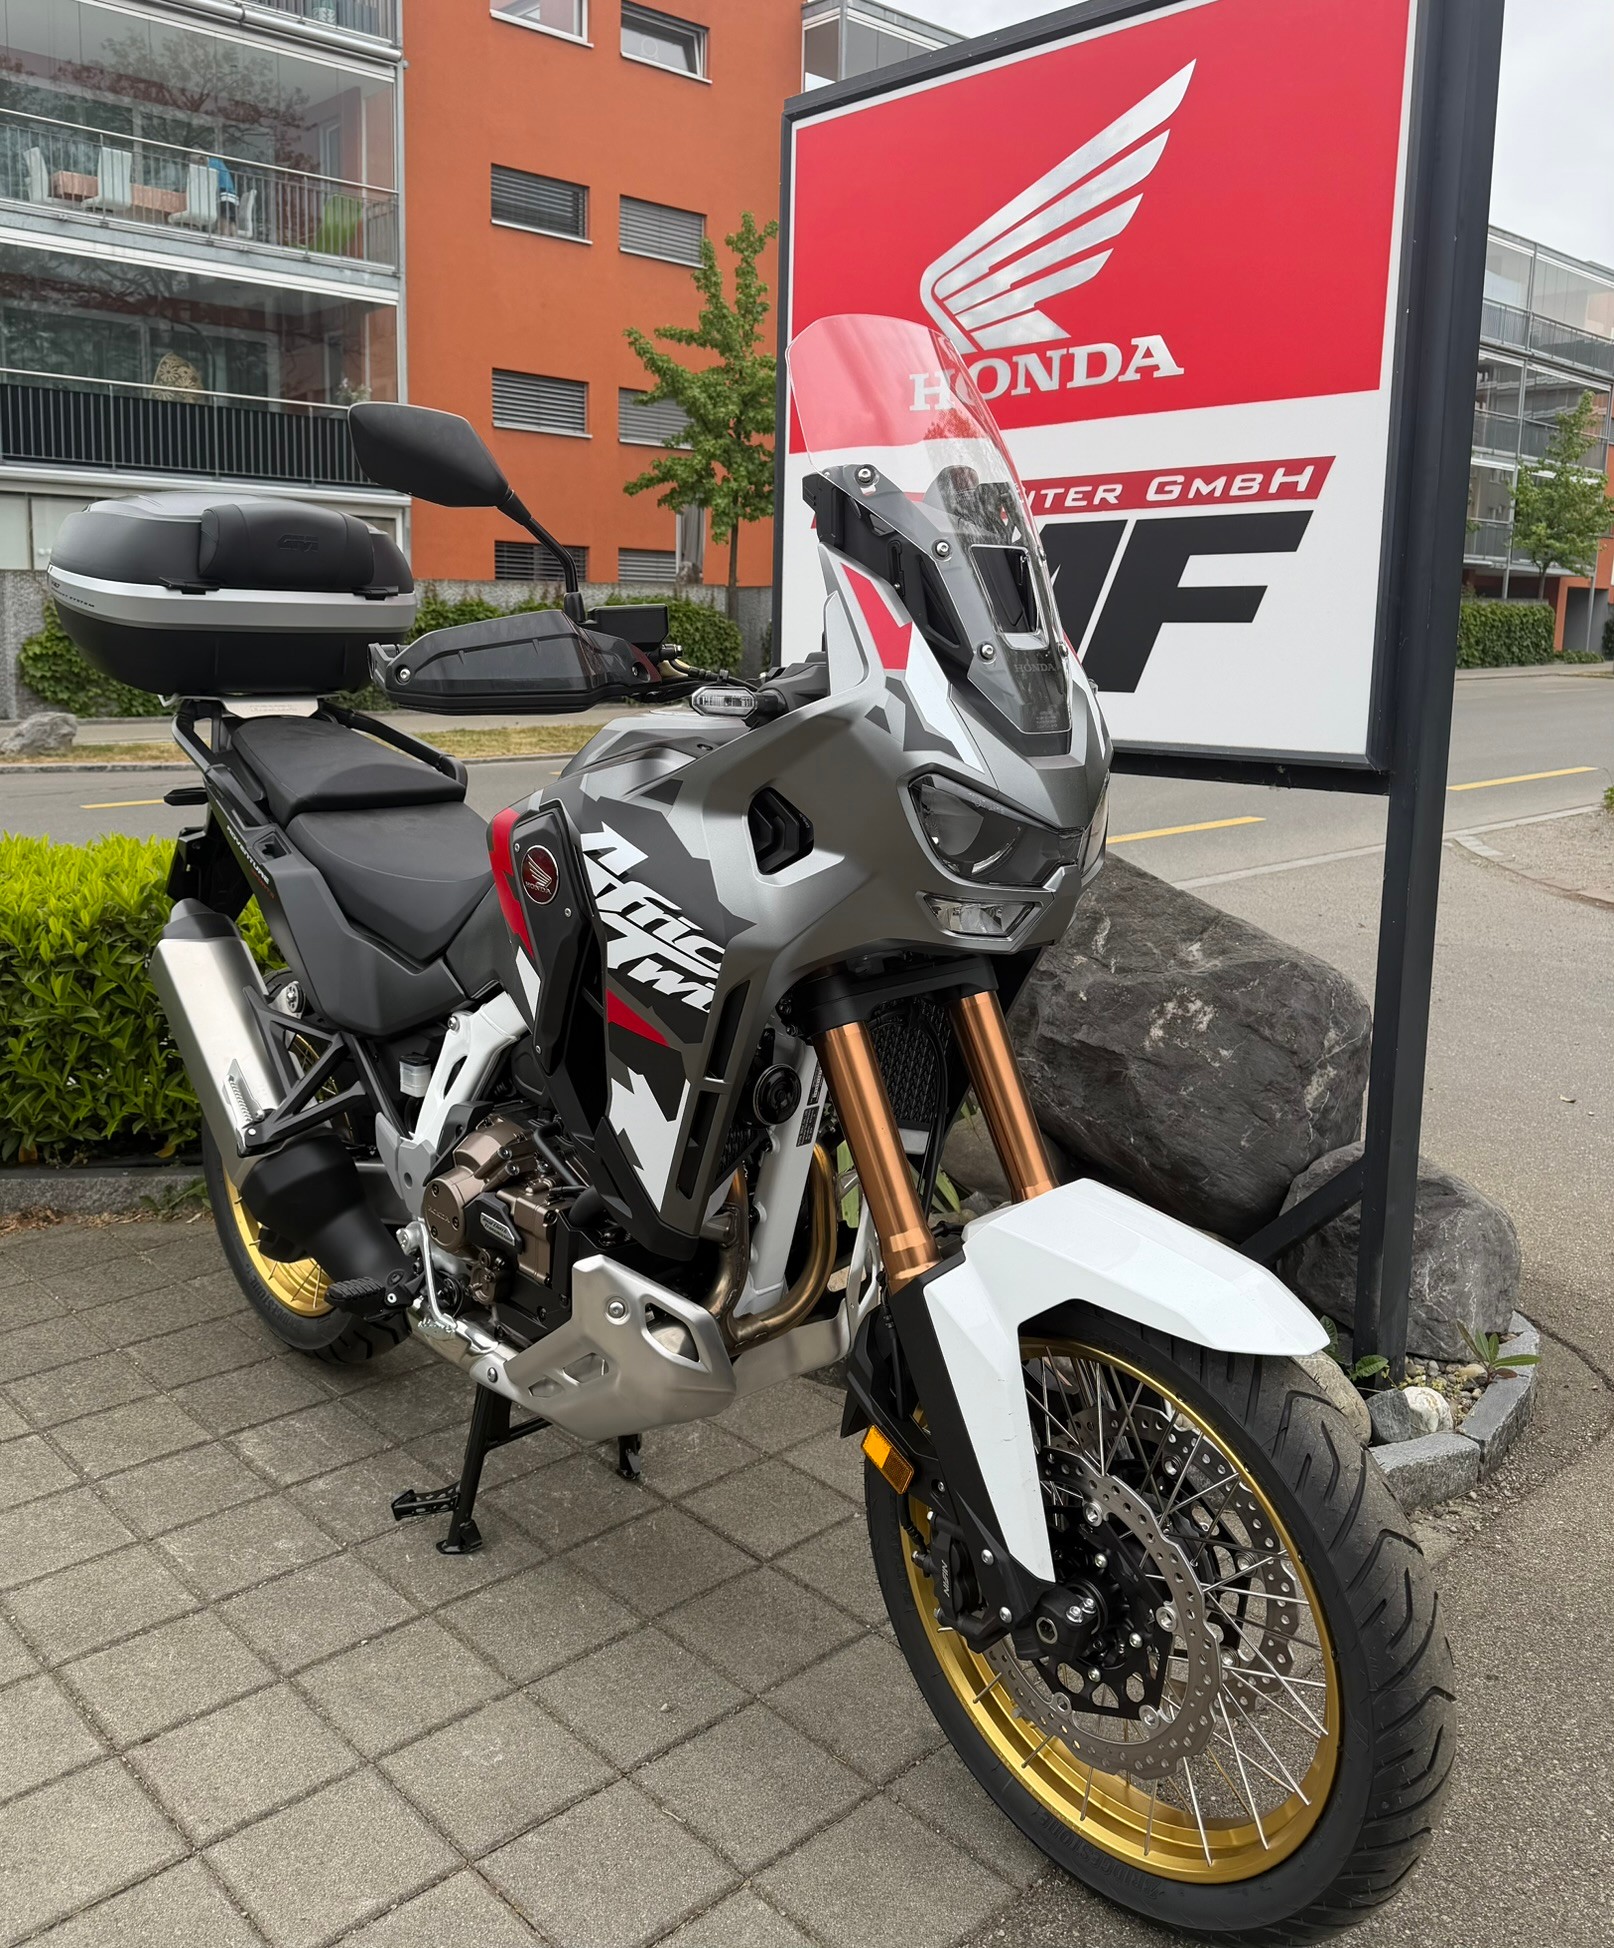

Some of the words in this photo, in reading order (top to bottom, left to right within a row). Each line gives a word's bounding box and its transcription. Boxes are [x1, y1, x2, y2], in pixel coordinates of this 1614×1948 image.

[908, 333, 1185, 412] HONDA
[1014, 663, 1057, 672] HONDA
[525, 881, 552, 895] HONDA
[581, 821, 725, 974] Afric
[941, 1559, 951, 1598] NISSIN
[1039, 1811, 1161, 1900] BRIDGESTONE
